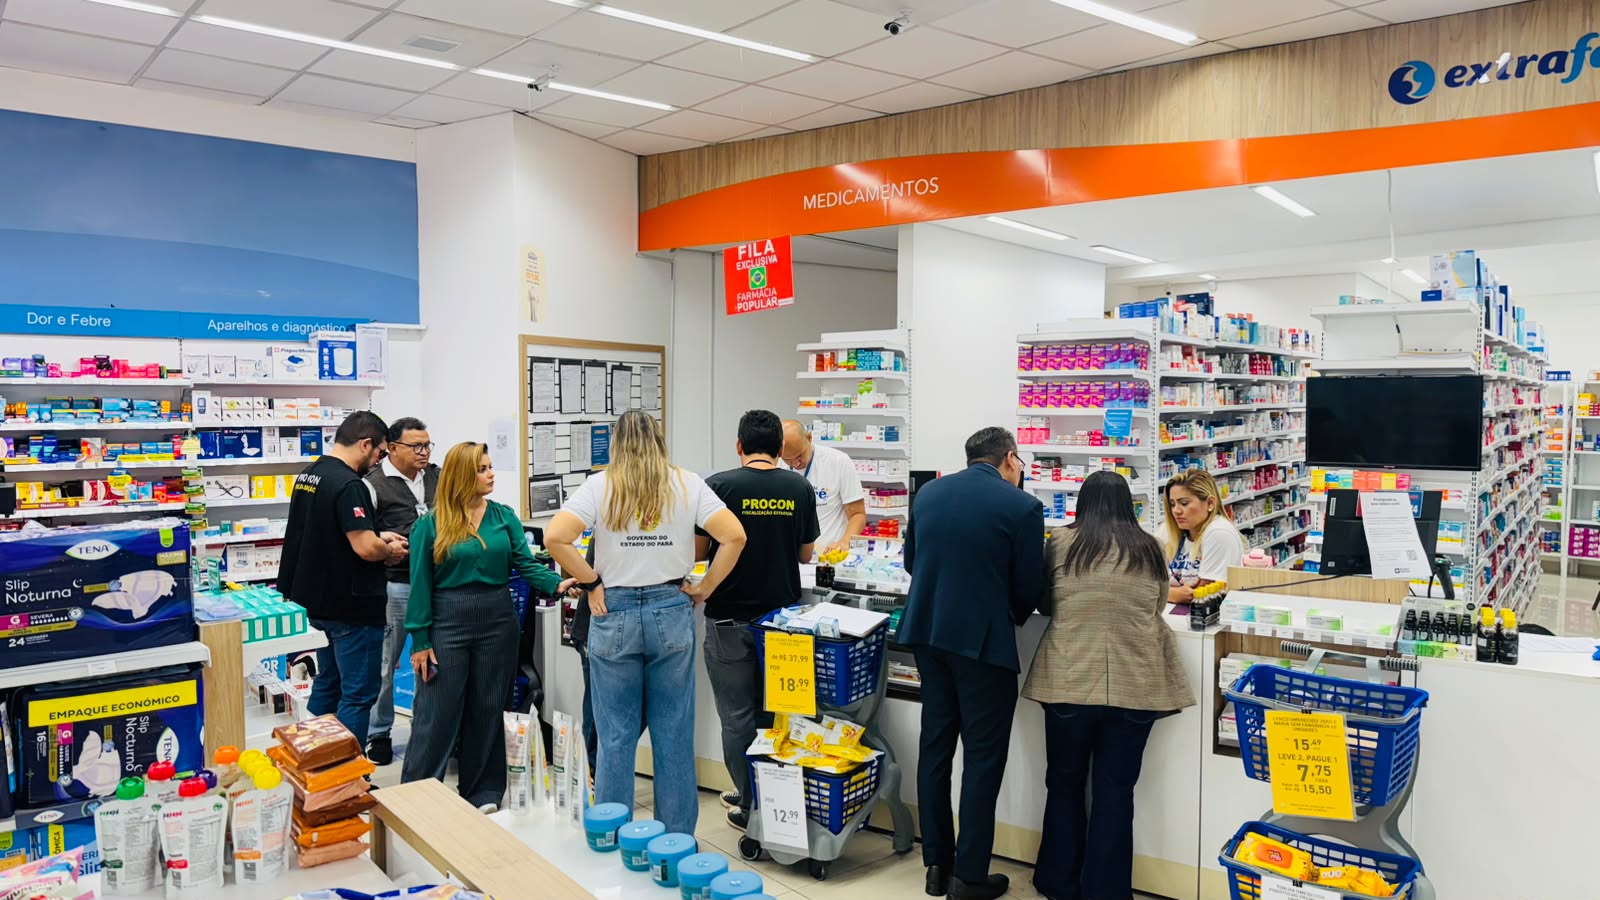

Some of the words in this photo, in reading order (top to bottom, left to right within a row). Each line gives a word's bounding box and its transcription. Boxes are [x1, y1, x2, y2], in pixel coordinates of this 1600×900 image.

[803, 177, 939, 210] MEDICAMENTOS
[737, 239, 776, 261] FILA
[736, 254, 778, 271] EXCLUSIVA
[736, 287, 777, 302] FARMÁCIA
[736, 296, 778, 312] POPULAR
[27, 312, 54, 326] Dor
[57, 315, 66, 326] e
[71, 313, 112, 328] Febre
[207, 319, 268, 332] Aparelhos
[271, 322, 279, 331] e
[282, 321, 346, 335] diagnóstico
[742, 498, 795, 511] PROCON
[78, 544, 110, 555] TENA
[5, 579, 30, 592] Slip
[5, 587, 72, 605] Noturna
[10, 615, 21, 625] G
[8, 637, 26, 648] 24
[788, 655, 809, 664] 37,99
[49, 705, 109, 720] EMPAQUE
[111, 694, 180, 712] ECONÓMICO
[138, 715, 150, 734] Slip
[36, 731, 47, 742] 16
[62, 730, 72, 739] G
[125, 717, 138, 772] Nocturno
[1293, 738, 1322, 751] 15,49
[1298, 754, 1305, 762] 2,
[1306, 755, 1331, 763] PAGUE
[1297, 764, 1332, 782] 7,75
[1303, 784, 1332, 795] 15,50
